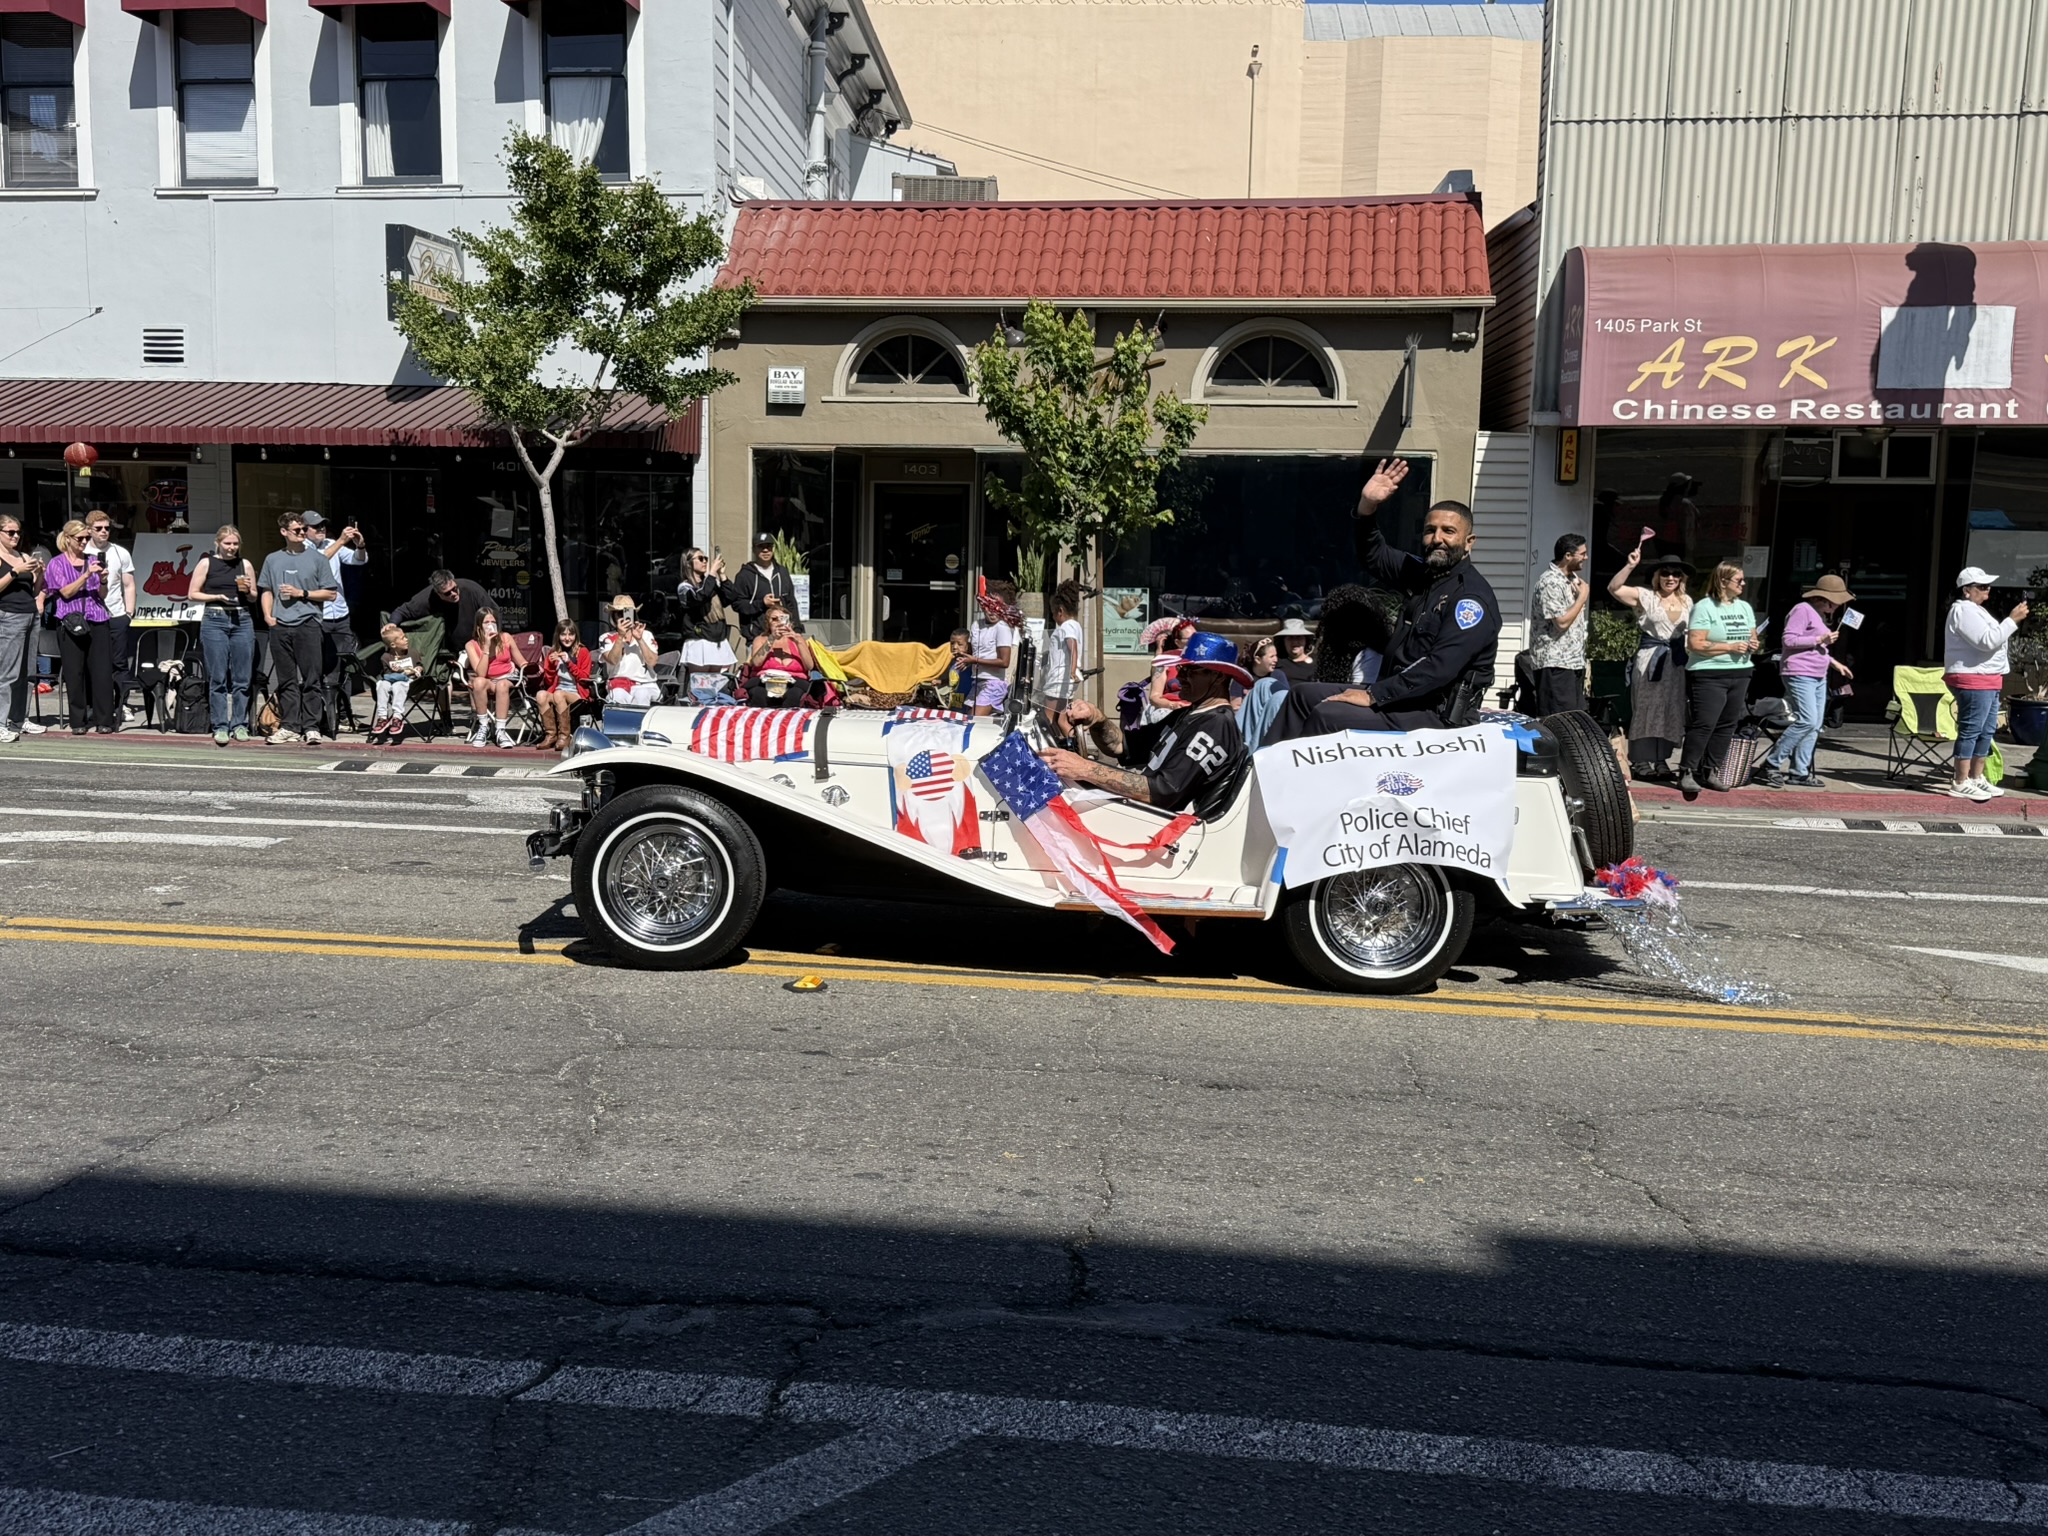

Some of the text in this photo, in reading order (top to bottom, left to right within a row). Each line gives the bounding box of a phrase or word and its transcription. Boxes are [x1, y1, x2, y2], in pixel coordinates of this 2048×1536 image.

[1594, 318, 1702, 333] 1405 Park St
[773, 370, 800, 379] BAY
[1627, 335, 1838, 392] ARK
[1612, 398, 1777, 420] Chinese
[1790, 397, 2019, 421] Restaurant
[1564, 433, 1574, 475] ARK
[904, 464, 937, 475] 1403
[481, 559, 525, 567] JEWELERS
[1185, 731, 1229, 776] 62
[1292, 734, 1486, 767] Nishant Joshi
[1340, 807, 1471, 835] Police Chief
[1323, 833, 1492, 869] City of Alameda
